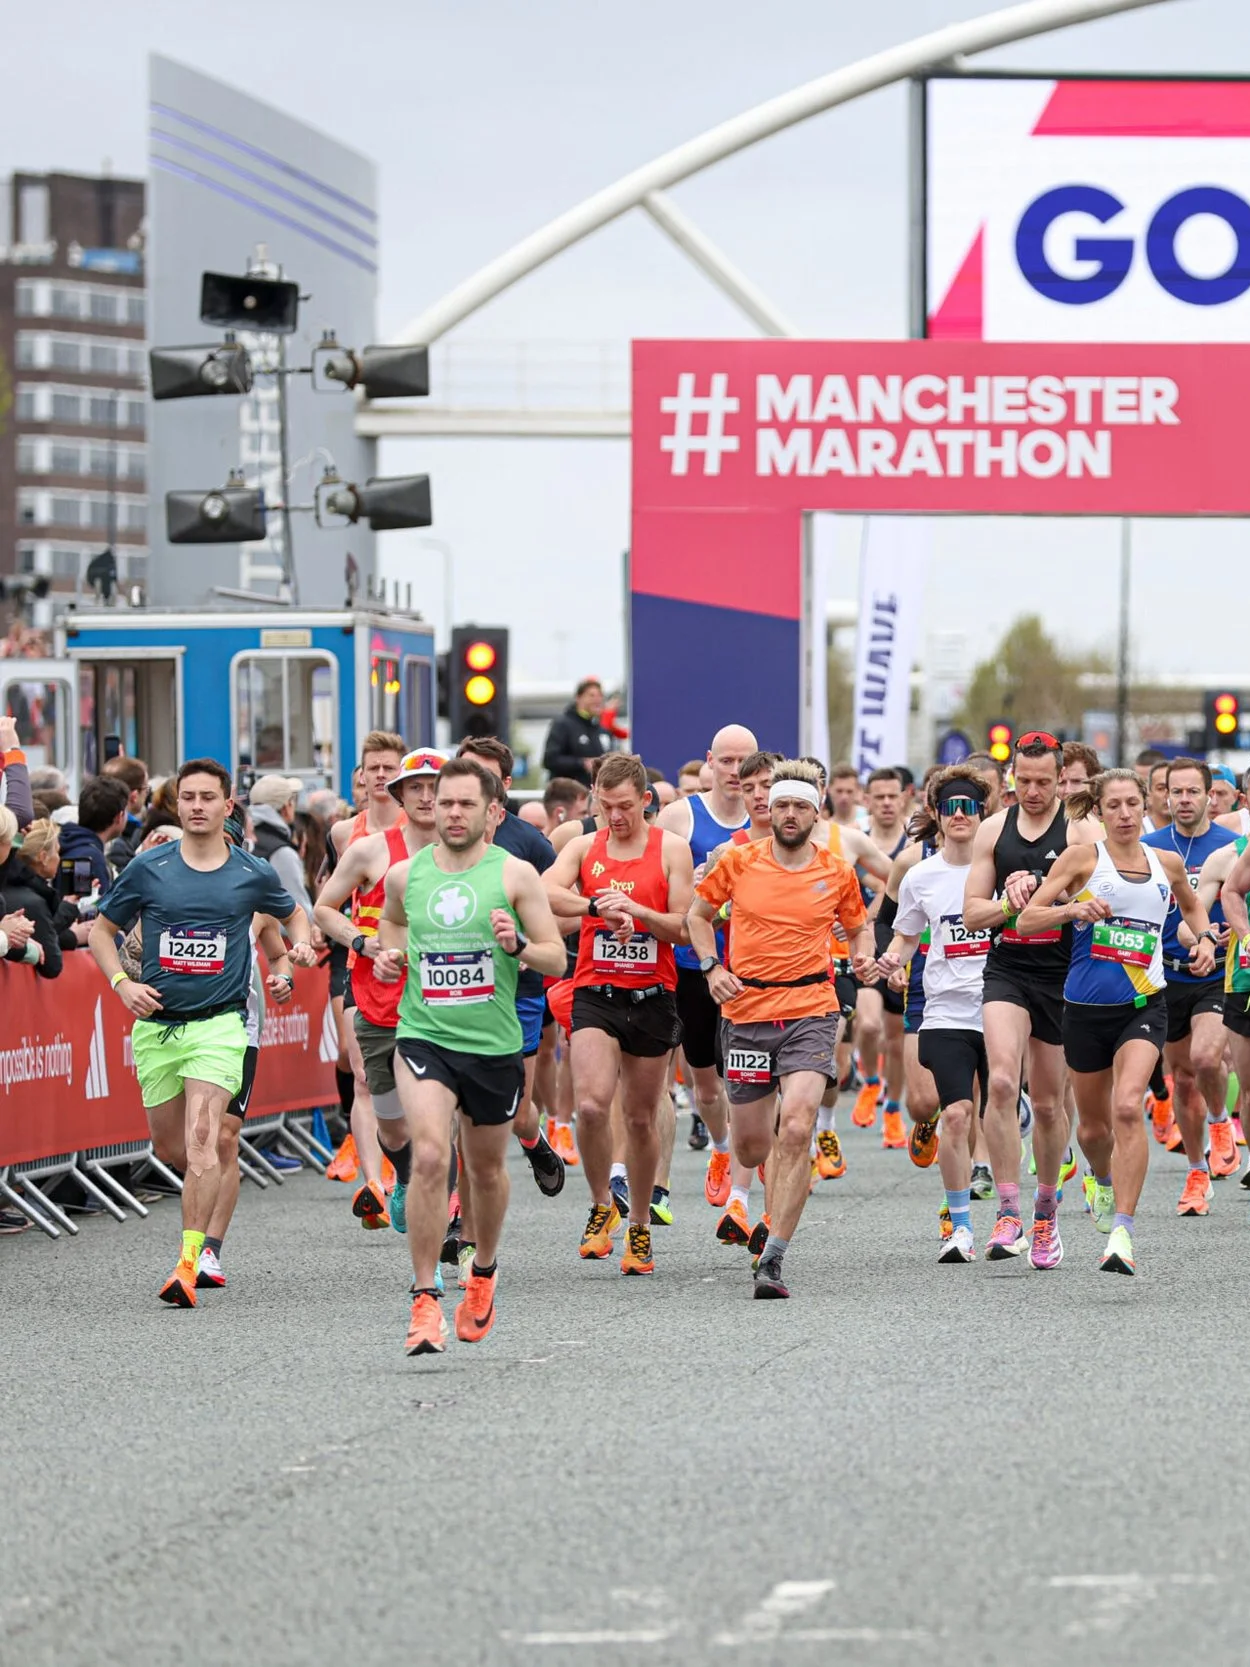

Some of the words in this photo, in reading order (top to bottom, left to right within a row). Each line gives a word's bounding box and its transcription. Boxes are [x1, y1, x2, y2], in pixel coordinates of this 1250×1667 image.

[756, 373, 1180, 425] MANCHESTER
[660, 373, 740, 476] #
[756, 428, 1112, 478] MARATHON
[610, 879, 635, 895] Prep
[168, 941, 218, 958] 12422
[1109, 930, 1145, 950] 1053
[602, 944, 649, 960] 12438
[427, 968, 485, 986] 10084
[35, 1035, 44, 1079] is
[44, 1032, 73, 1086] nothing
[730, 1054, 768, 1069] 11122
